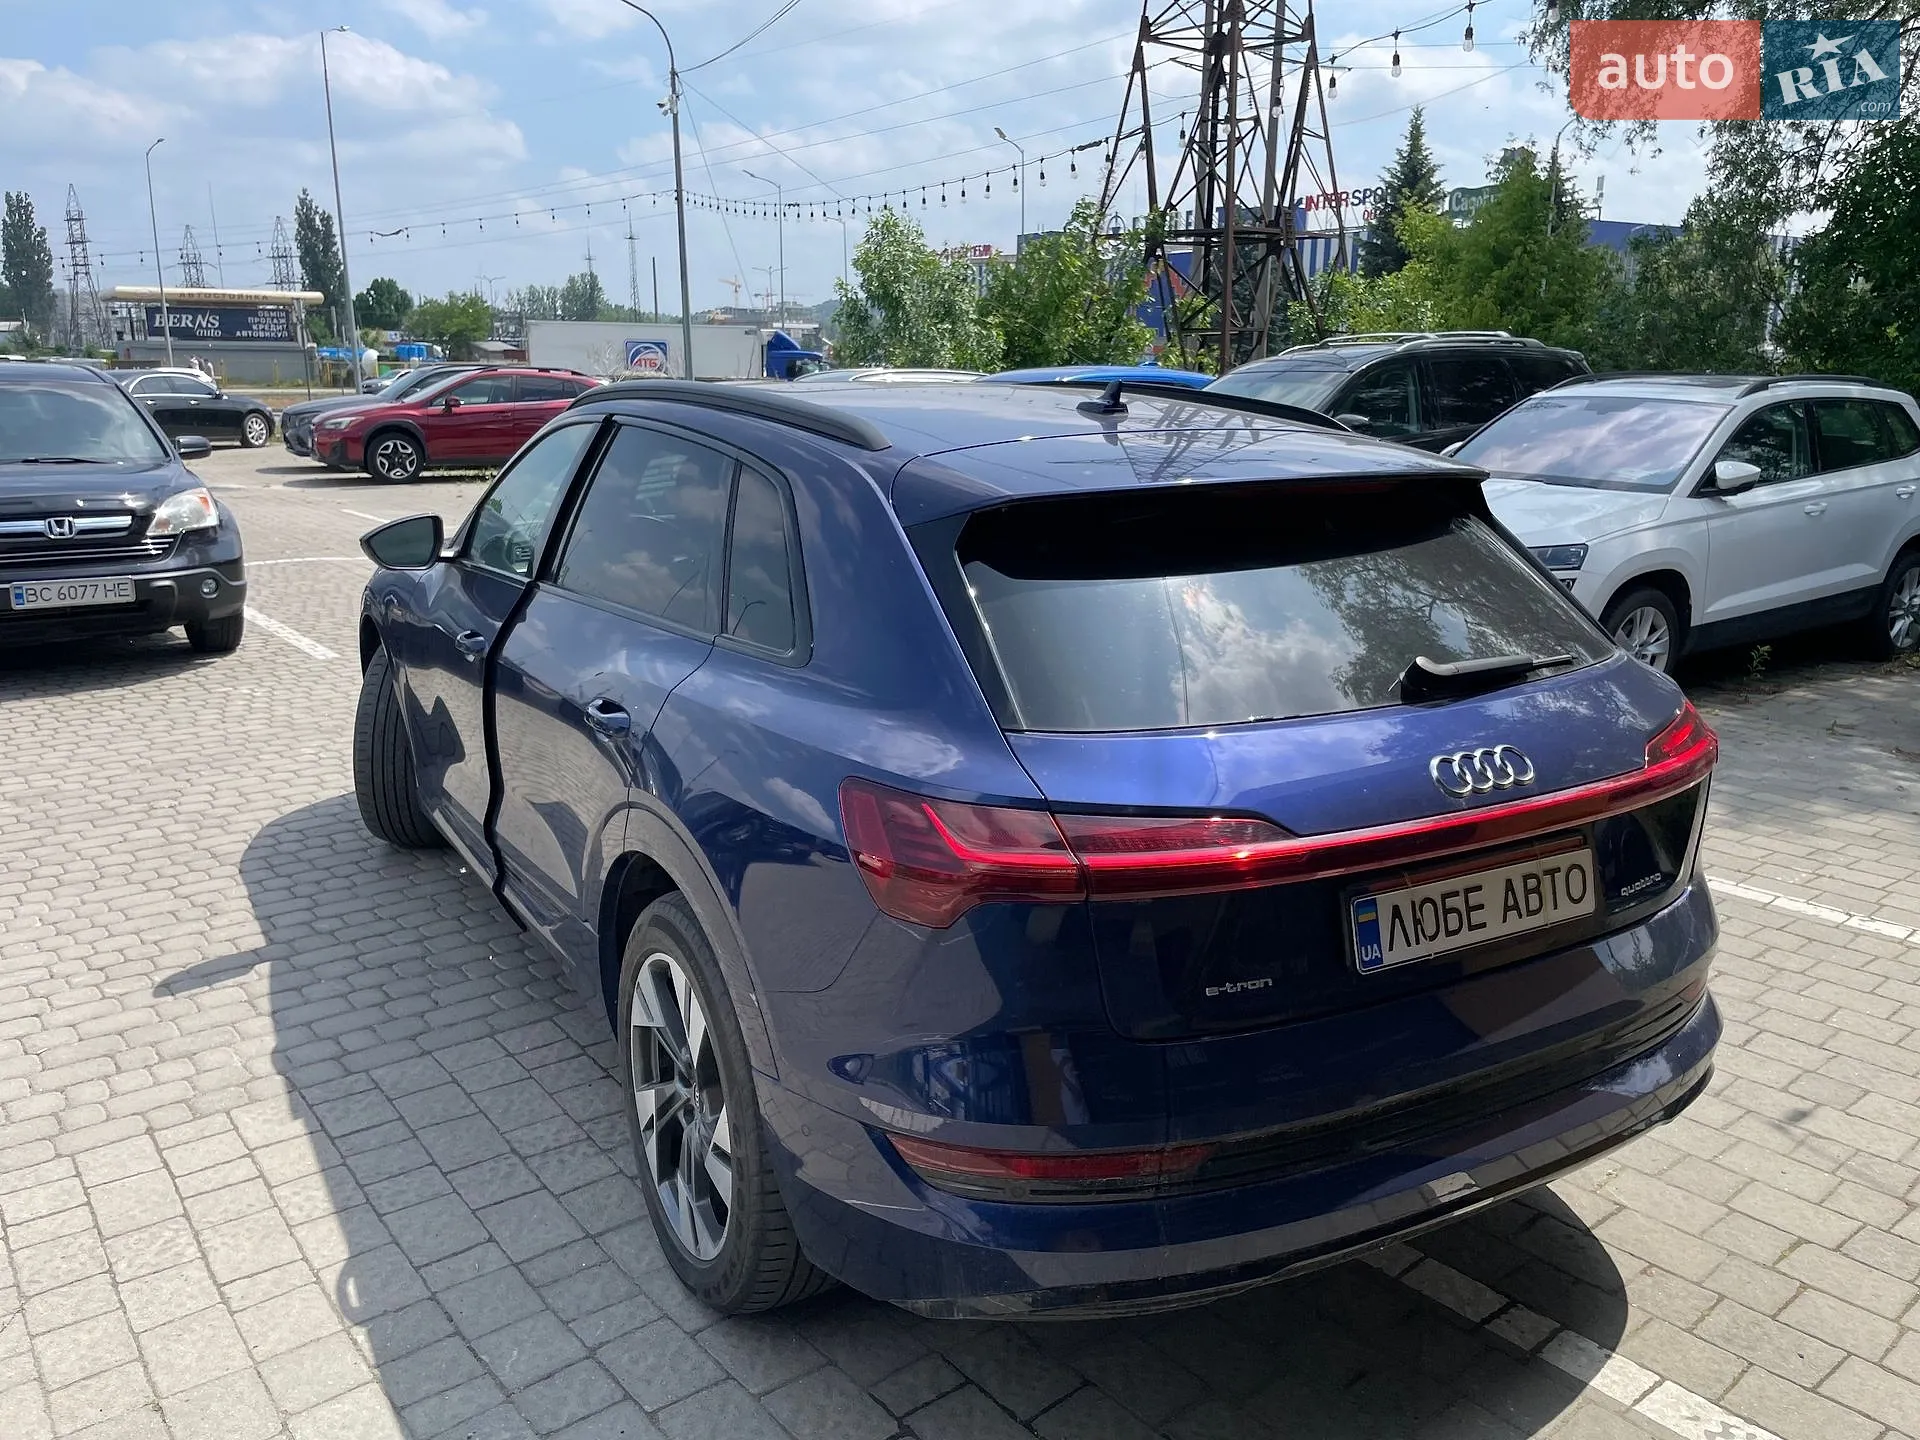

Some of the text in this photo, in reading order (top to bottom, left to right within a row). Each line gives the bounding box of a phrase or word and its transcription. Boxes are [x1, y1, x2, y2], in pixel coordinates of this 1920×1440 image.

[248, 317, 287, 325] ПРОДАЖ
[196, 329, 222, 337] auto
[57, 584, 99, 600] 6077
[1620, 872, 1662, 897] quattro
[1388, 863, 1587, 952] ЛЮБЕ АВТО
[1361, 944, 1382, 961] UA
[1205, 978, 1273, 996] e-tron
